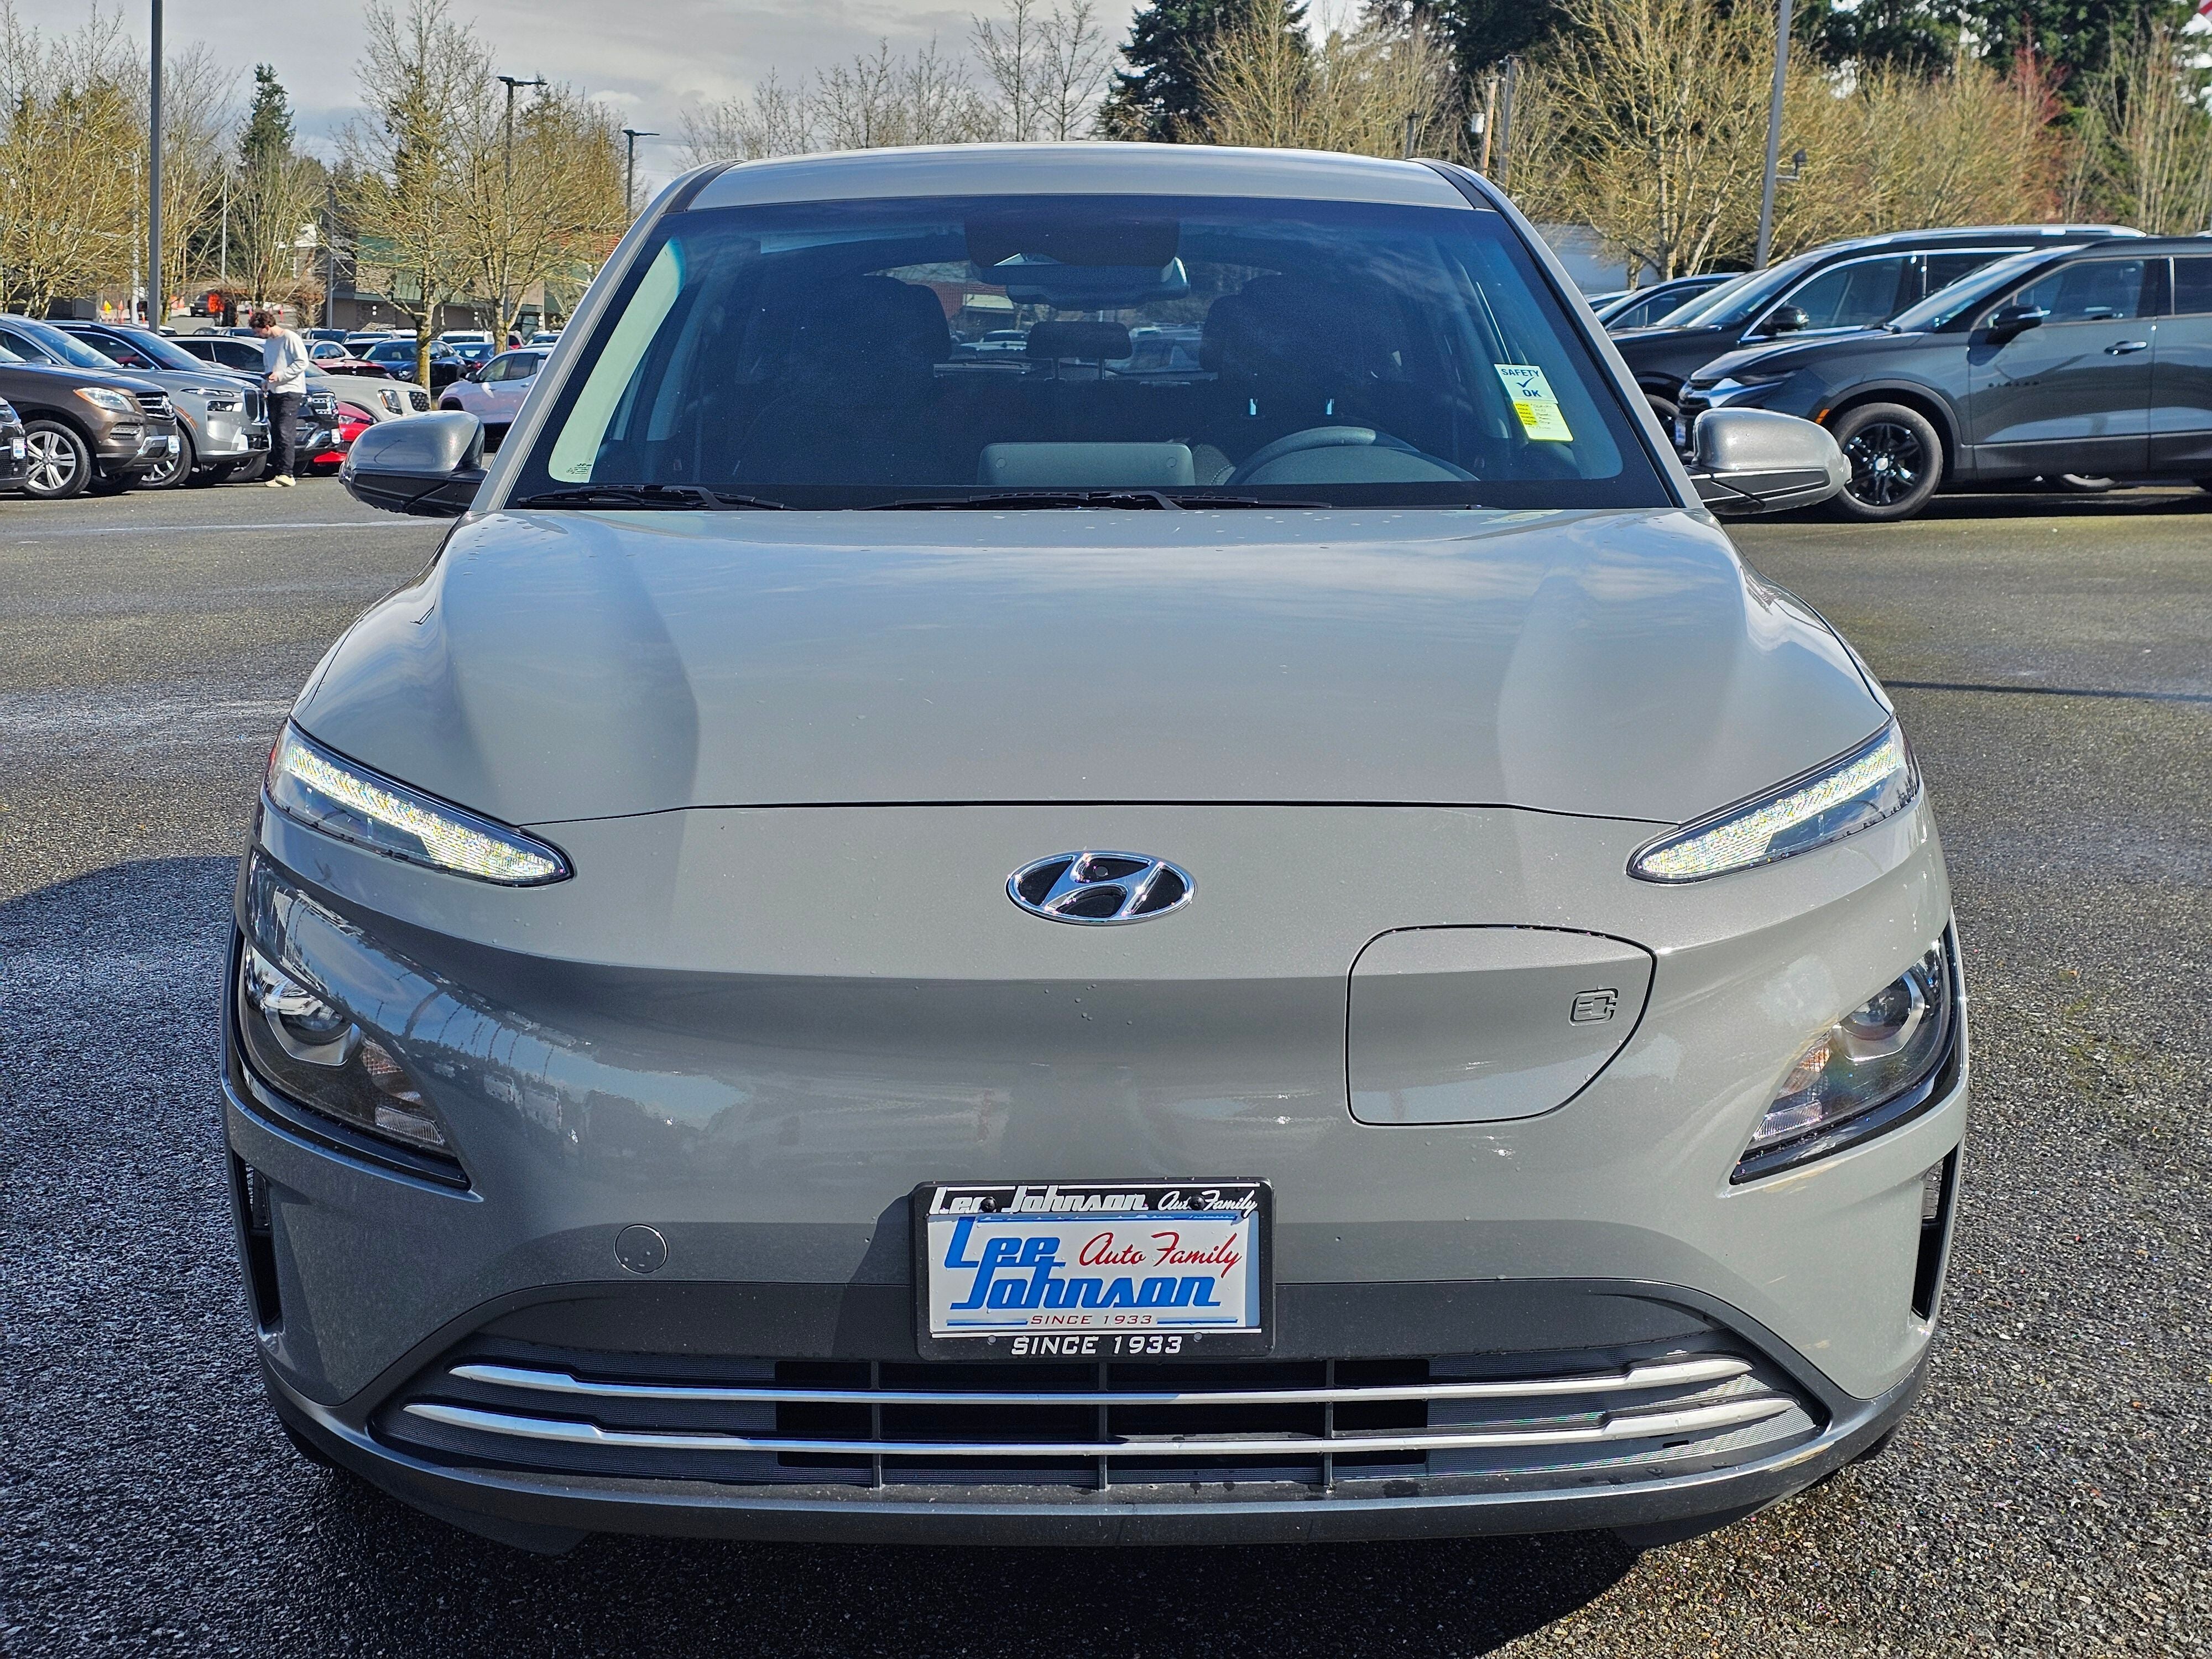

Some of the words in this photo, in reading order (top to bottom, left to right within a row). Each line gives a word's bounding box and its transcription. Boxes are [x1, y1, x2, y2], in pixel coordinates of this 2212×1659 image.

[1501, 368, 1540, 377] SAFETY
[1522, 389, 1542, 398] OK
[1001, 1185, 1149, 1212] Johnson
[1157, 1191, 1202, 1211] Aut
[1201, 1190, 1258, 1218] Family
[945, 1216, 1066, 1269] Lee
[1079, 1232, 1147, 1266] Auto
[1150, 1232, 1243, 1279] Family
[950, 1256, 1221, 1310] Johnson
[1030, 1314, 1093, 1324] SINCE
[1104, 1315, 1152, 1324] 1933
[1011, 1336, 1099, 1355] SINCE
[1113, 1335, 1182, 1354] 1933
